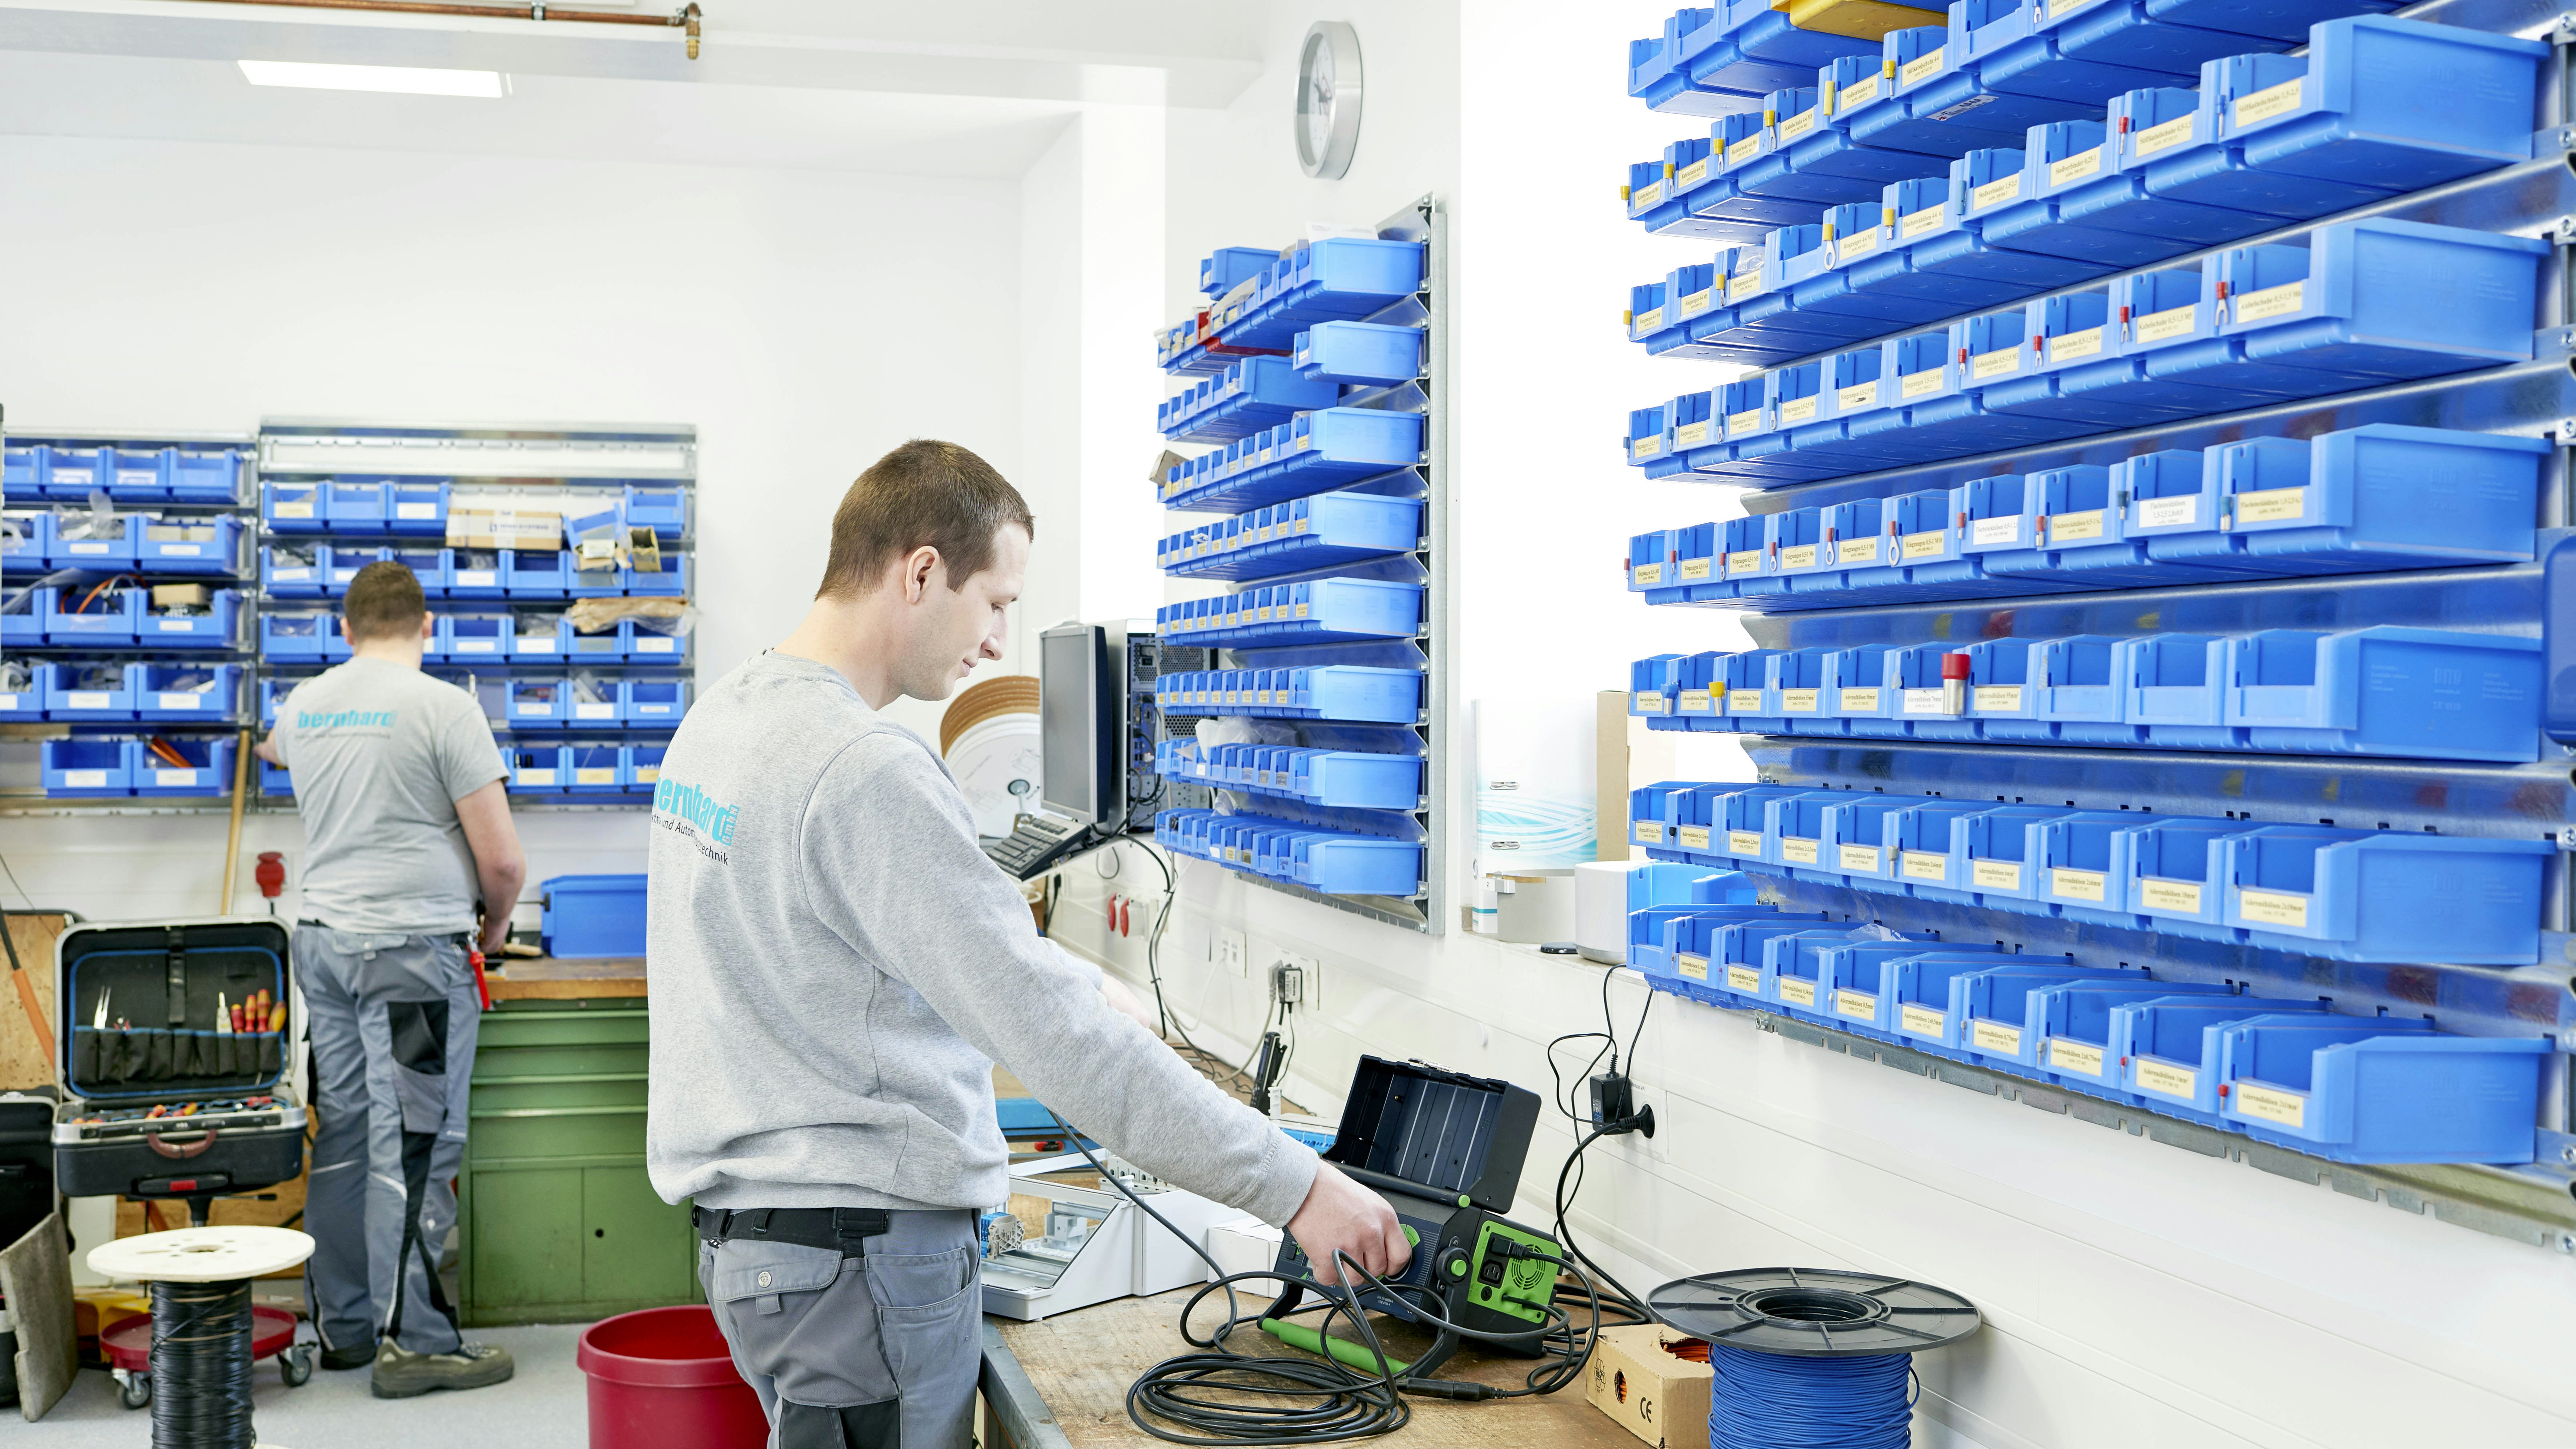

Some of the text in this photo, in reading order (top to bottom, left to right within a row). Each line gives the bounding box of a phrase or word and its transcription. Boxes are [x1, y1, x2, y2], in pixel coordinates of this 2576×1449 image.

[1785, 119, 1802, 131] Kabelschuhe
[297, 710, 399, 728] bernhard
[662, 819, 675, 830] und
[1840, 997, 1862, 1007] Aderendhülsen
[1640, 1397, 1652, 1423] CE
